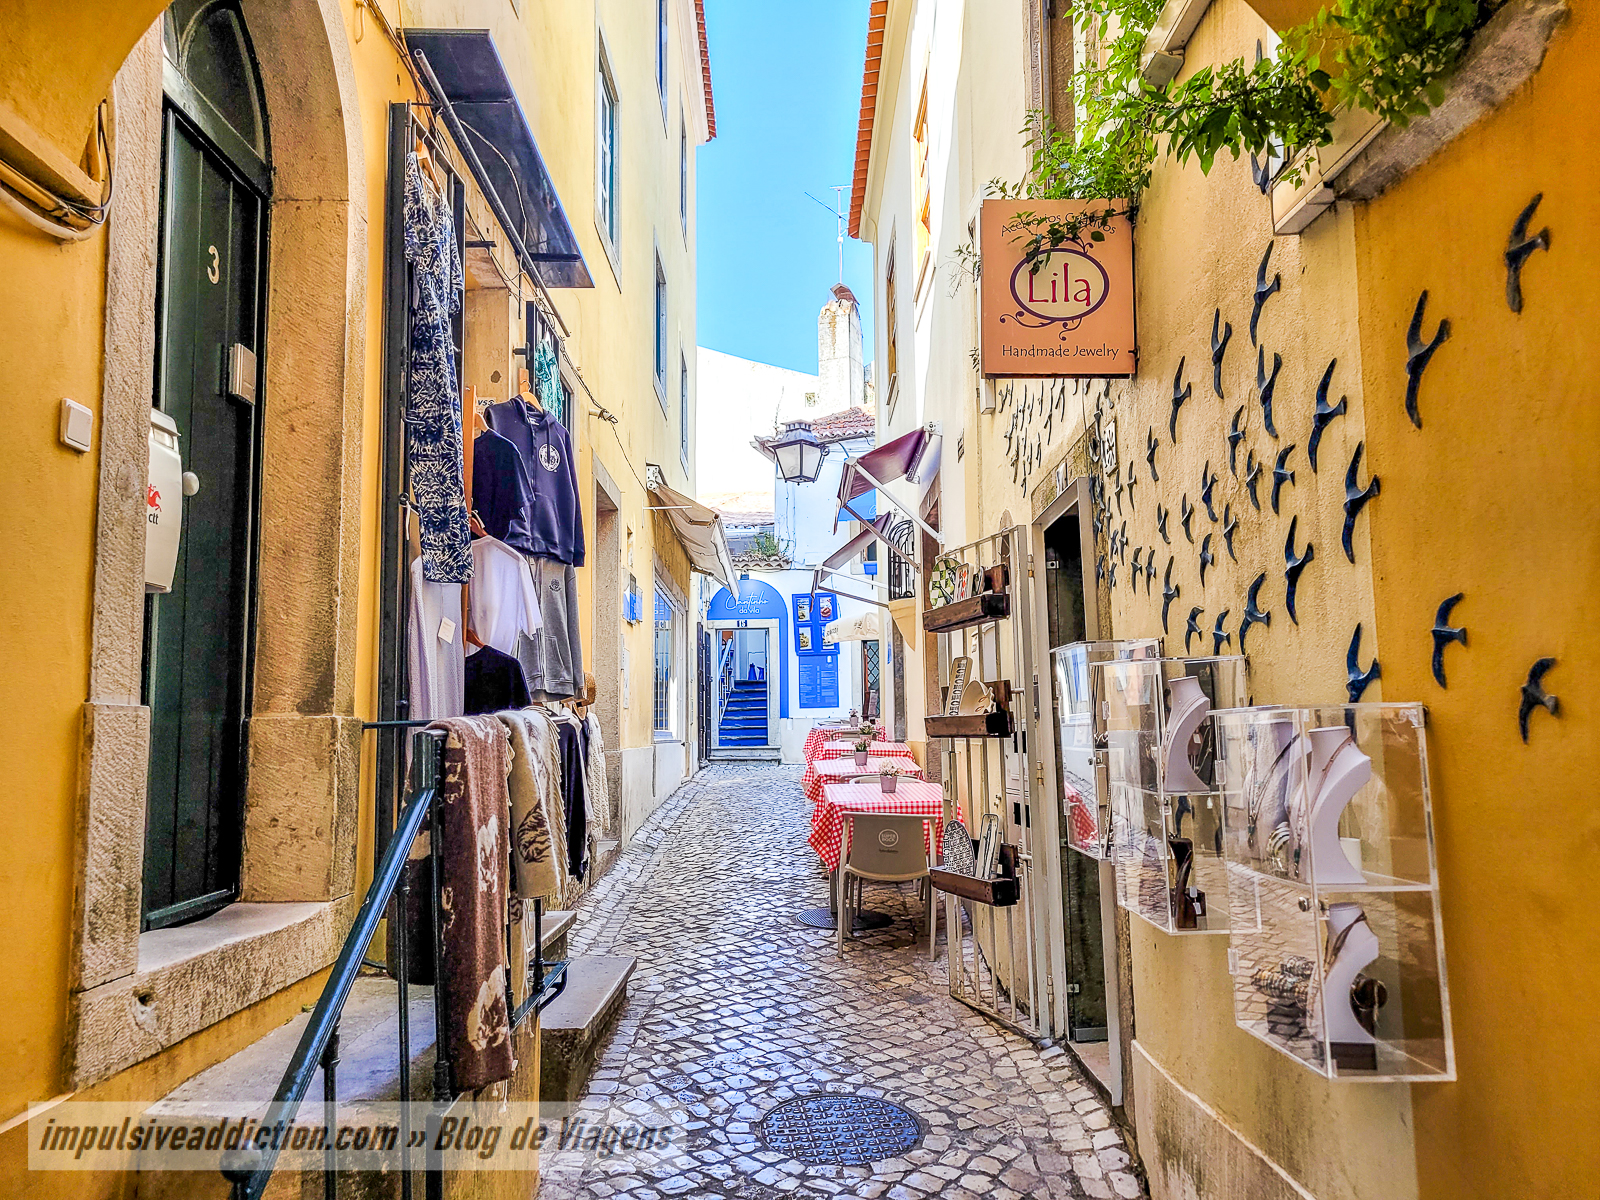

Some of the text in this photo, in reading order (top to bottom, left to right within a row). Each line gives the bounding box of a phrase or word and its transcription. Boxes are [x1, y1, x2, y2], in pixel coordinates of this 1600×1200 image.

[207, 245, 219, 284] 3
[1027, 262, 1092, 307] Lila
[1001, 343, 1120, 360] Handmade Jewelry
[148, 512, 159, 525] ctt
[725, 590, 769, 610] Cantinho
[739, 606, 747, 614] da
